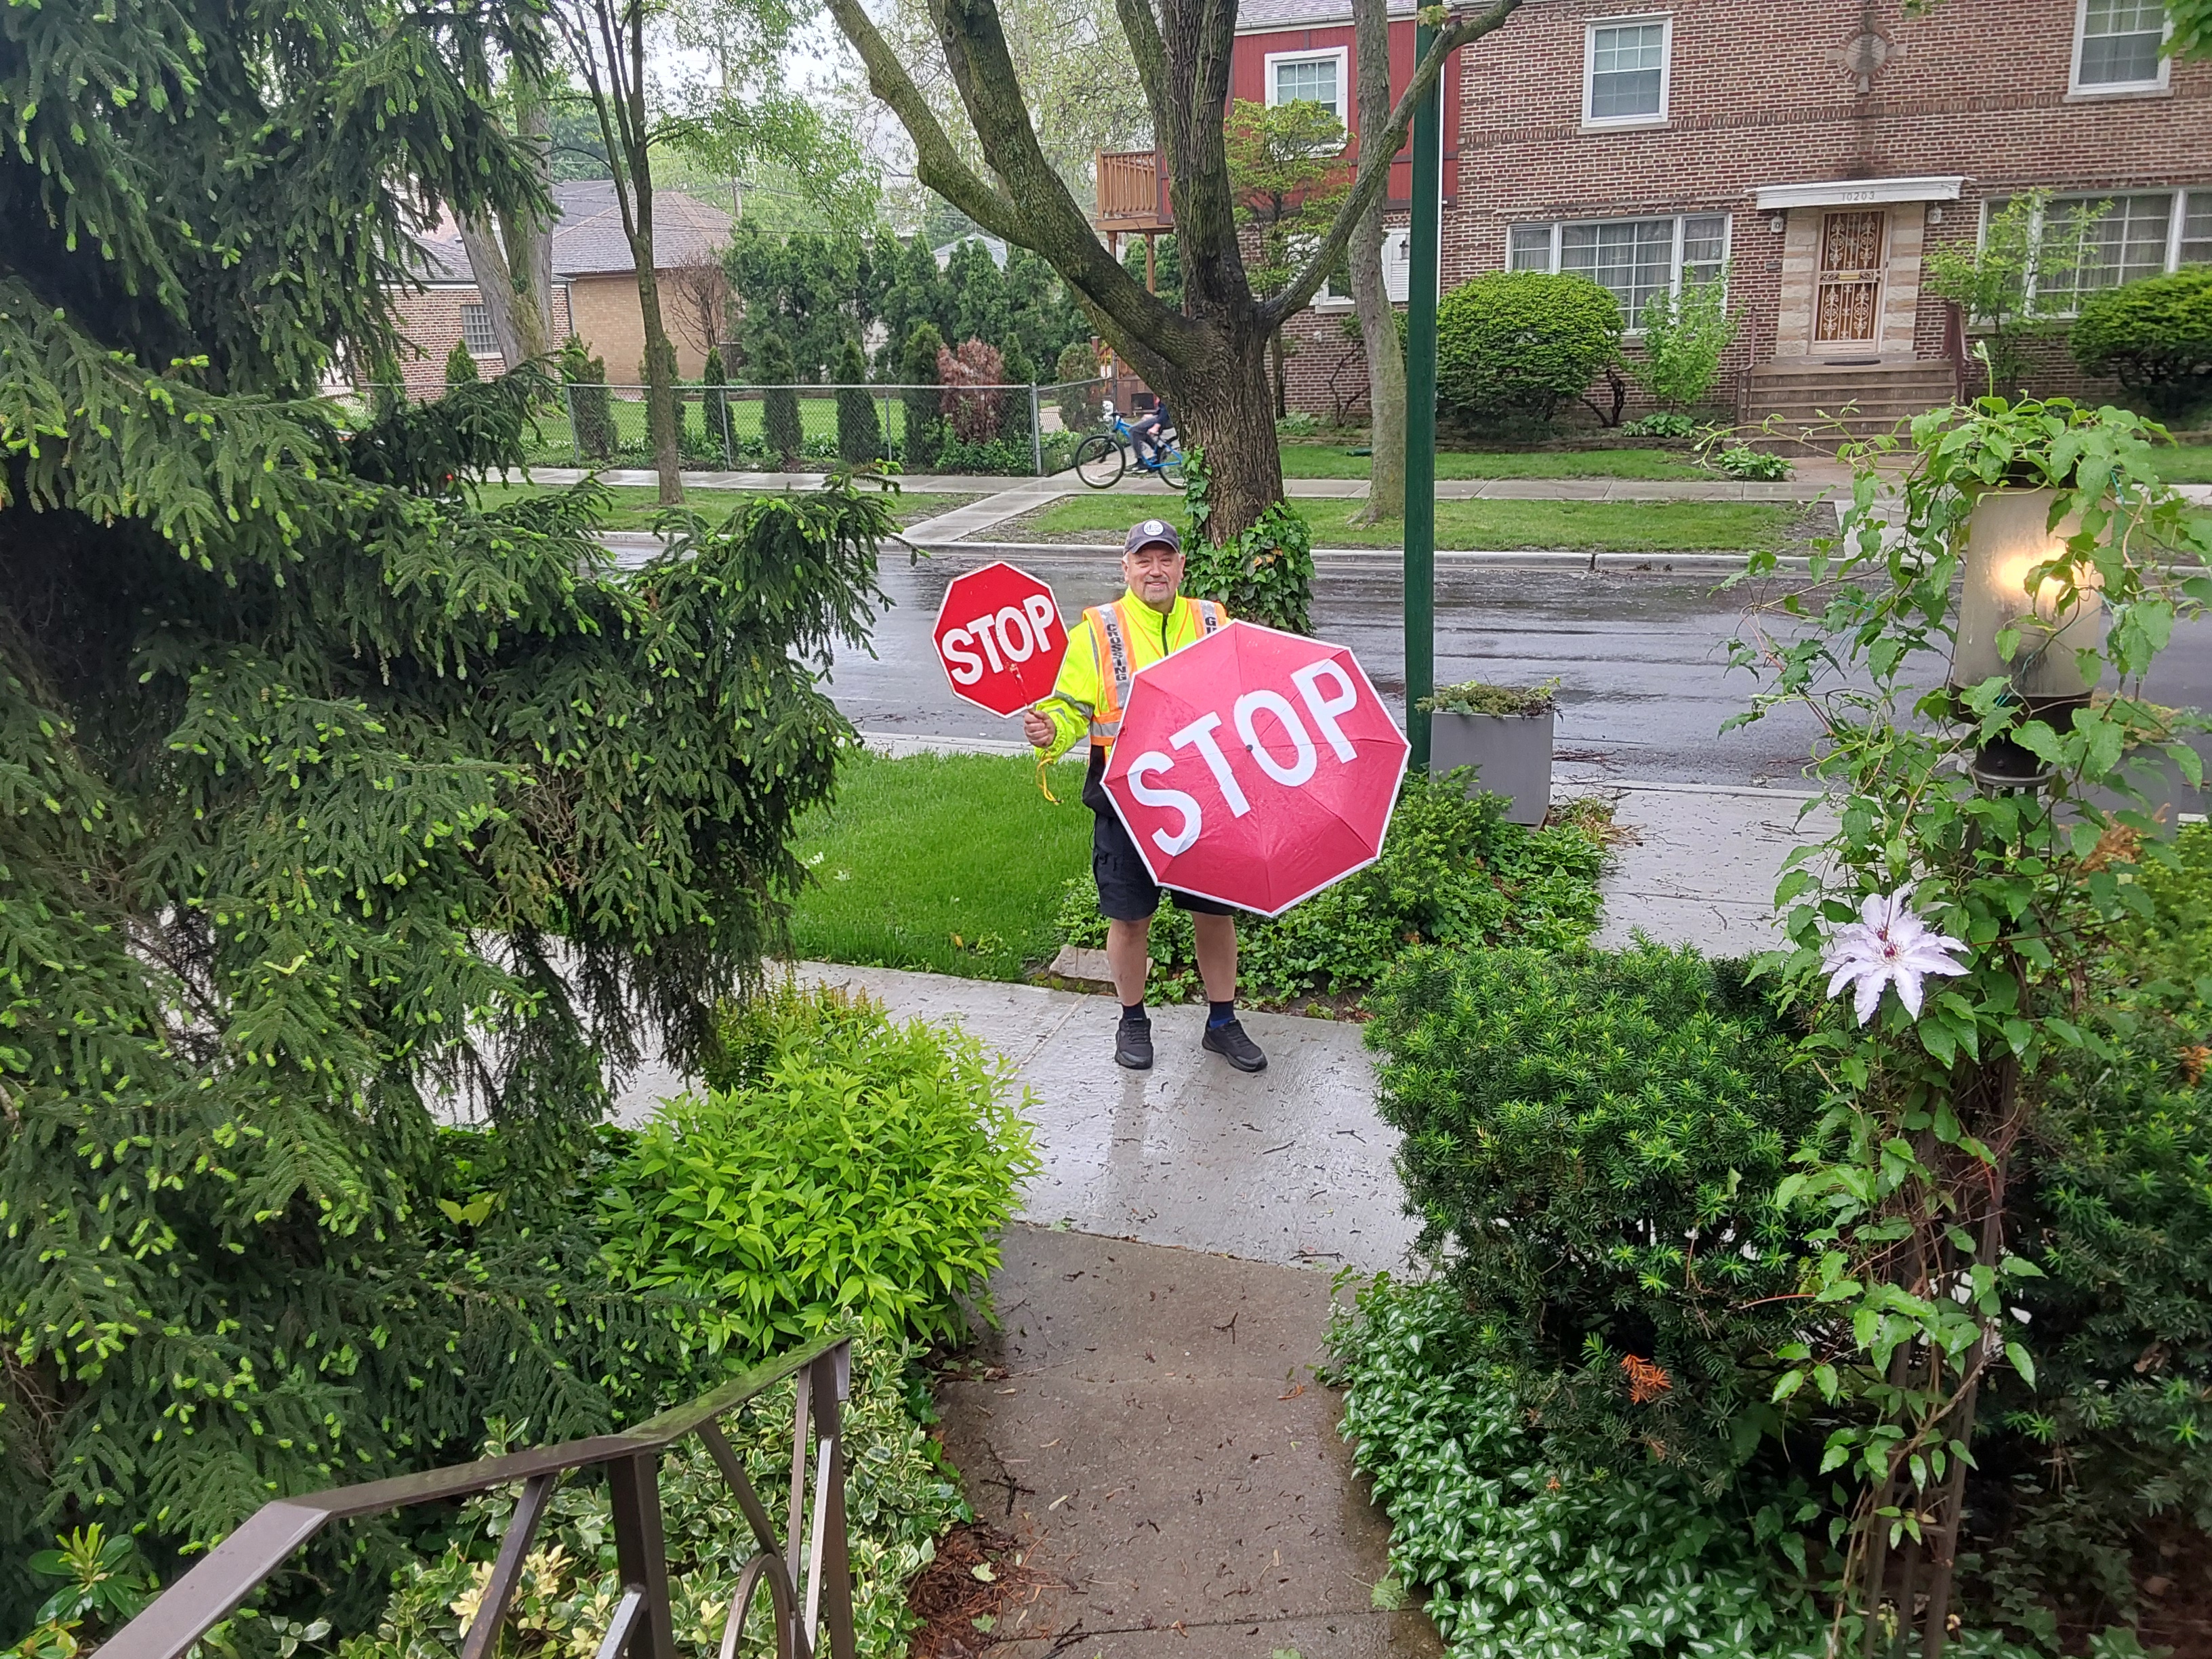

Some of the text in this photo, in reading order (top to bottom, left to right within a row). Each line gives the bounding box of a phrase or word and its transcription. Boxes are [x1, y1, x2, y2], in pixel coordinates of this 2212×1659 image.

[1842, 191, 1875, 201] 10203
[942, 594, 1054, 685] STOP
[1106, 623, 1126, 681] CROSSING
[1127, 659, 1357, 856] STOP
